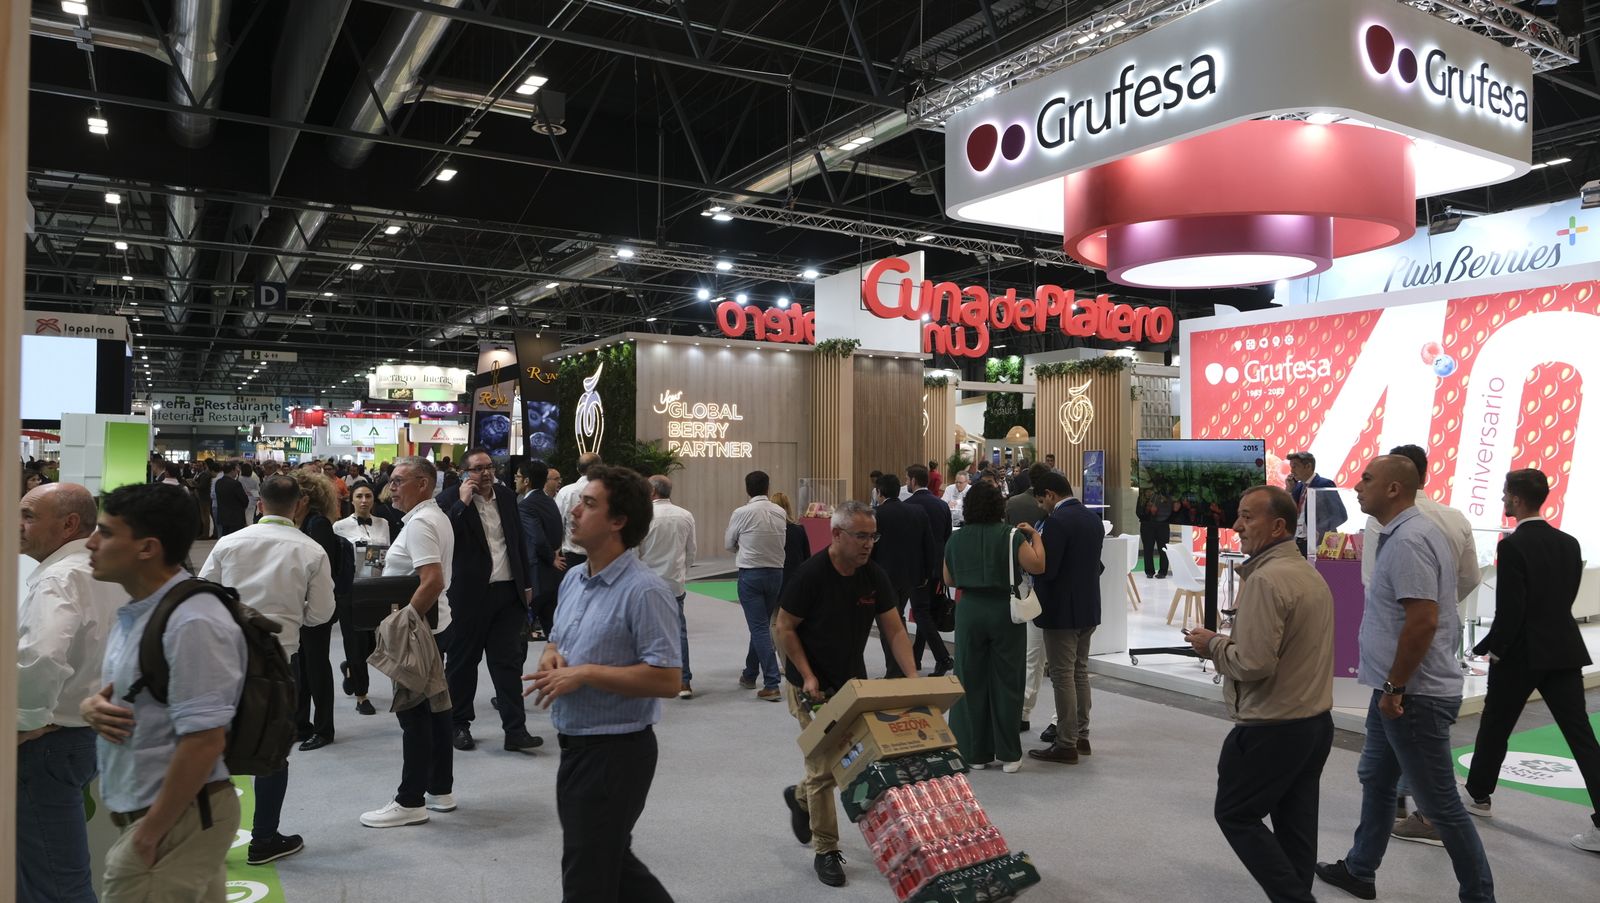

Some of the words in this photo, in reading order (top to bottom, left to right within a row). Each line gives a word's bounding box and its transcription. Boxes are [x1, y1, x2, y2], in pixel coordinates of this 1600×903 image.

[1425, 49, 1529, 124] Grufesa
[1036, 53, 1218, 149] Grufesa
[261, 286, 279, 306] D
[1033, 284, 1174, 343] Platero
[64, 323, 114, 335] lapalma
[1244, 355, 1331, 383] Grufesa
[204, 400, 281, 412] Restaurante
[653, 390, 683, 414] Your
[668, 402, 743, 421] GLOBAL
[668, 421, 729, 439] BERRY
[668, 440, 753, 458] PARTNER
[1468, 377, 1505, 517] aniversario
[888, 718, 932, 734] BEZOYA
